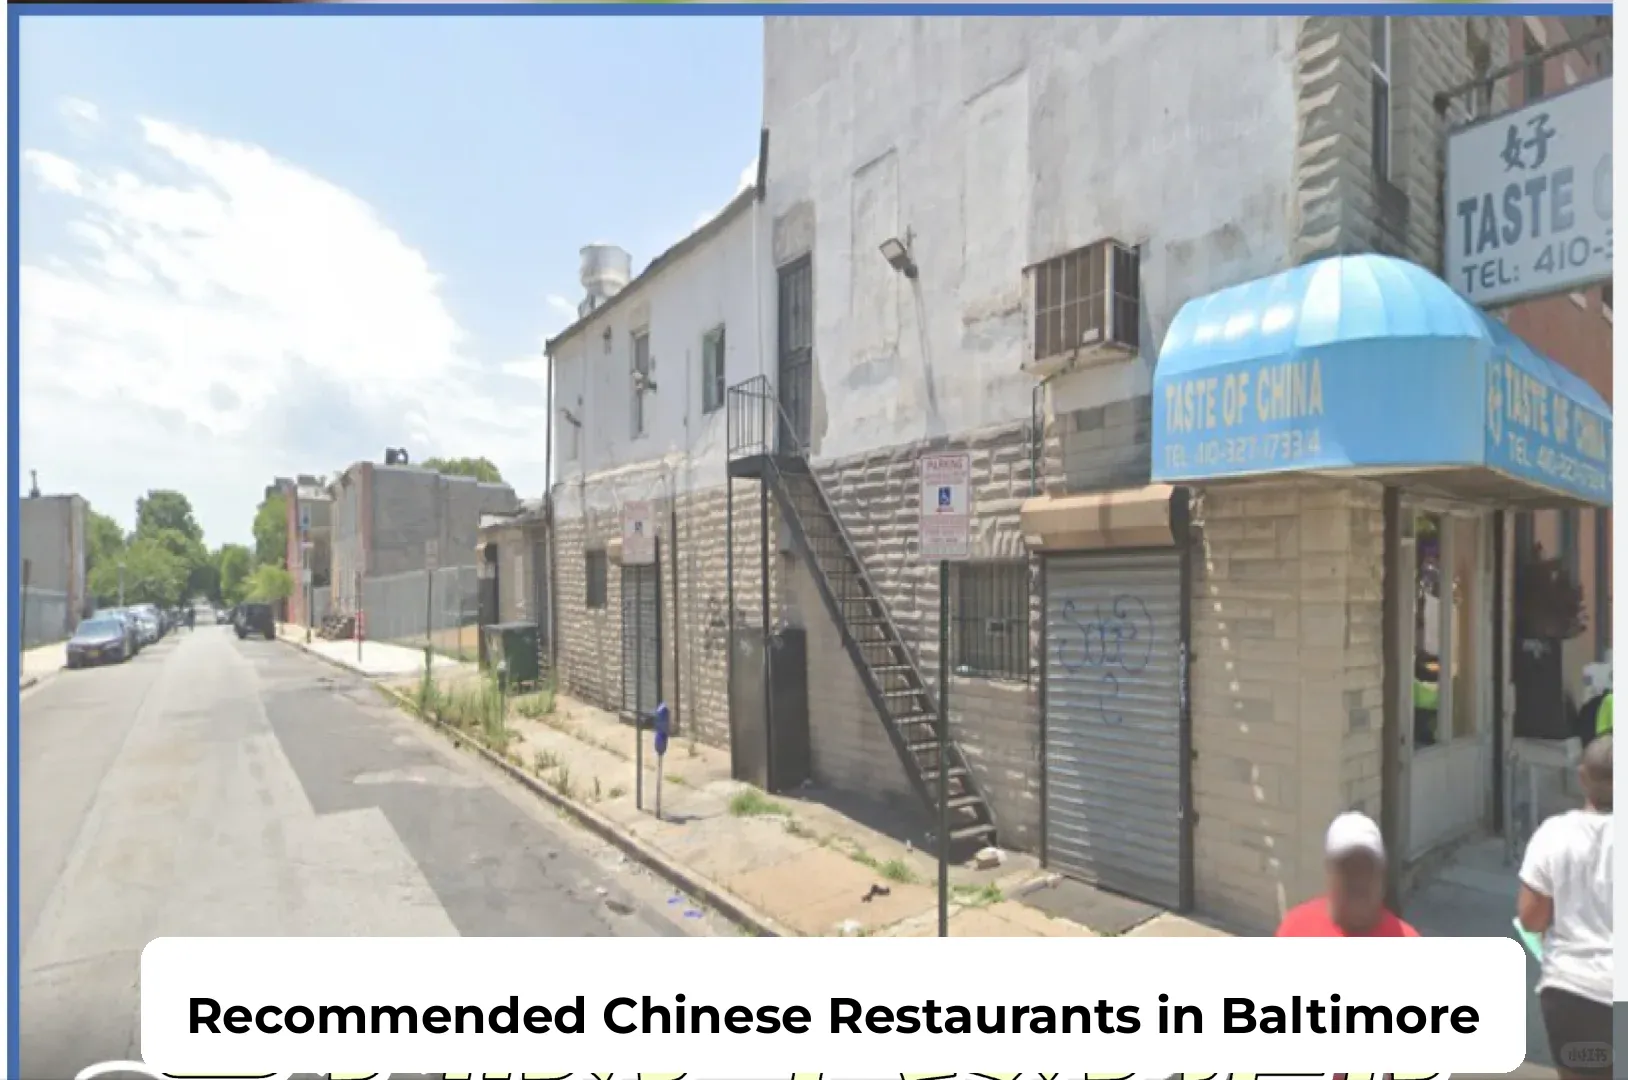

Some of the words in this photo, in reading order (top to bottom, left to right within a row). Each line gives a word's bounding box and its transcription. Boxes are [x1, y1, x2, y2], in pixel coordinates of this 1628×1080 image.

[1500, 113, 1555, 171] 好
[1457, 166, 1574, 257] TASTE
[1462, 259, 1520, 293] TEL:
[1165, 377, 1218, 434] TASTE
[1222, 371, 1249, 427] OF
[1256, 357, 1323, 423] CHINA
